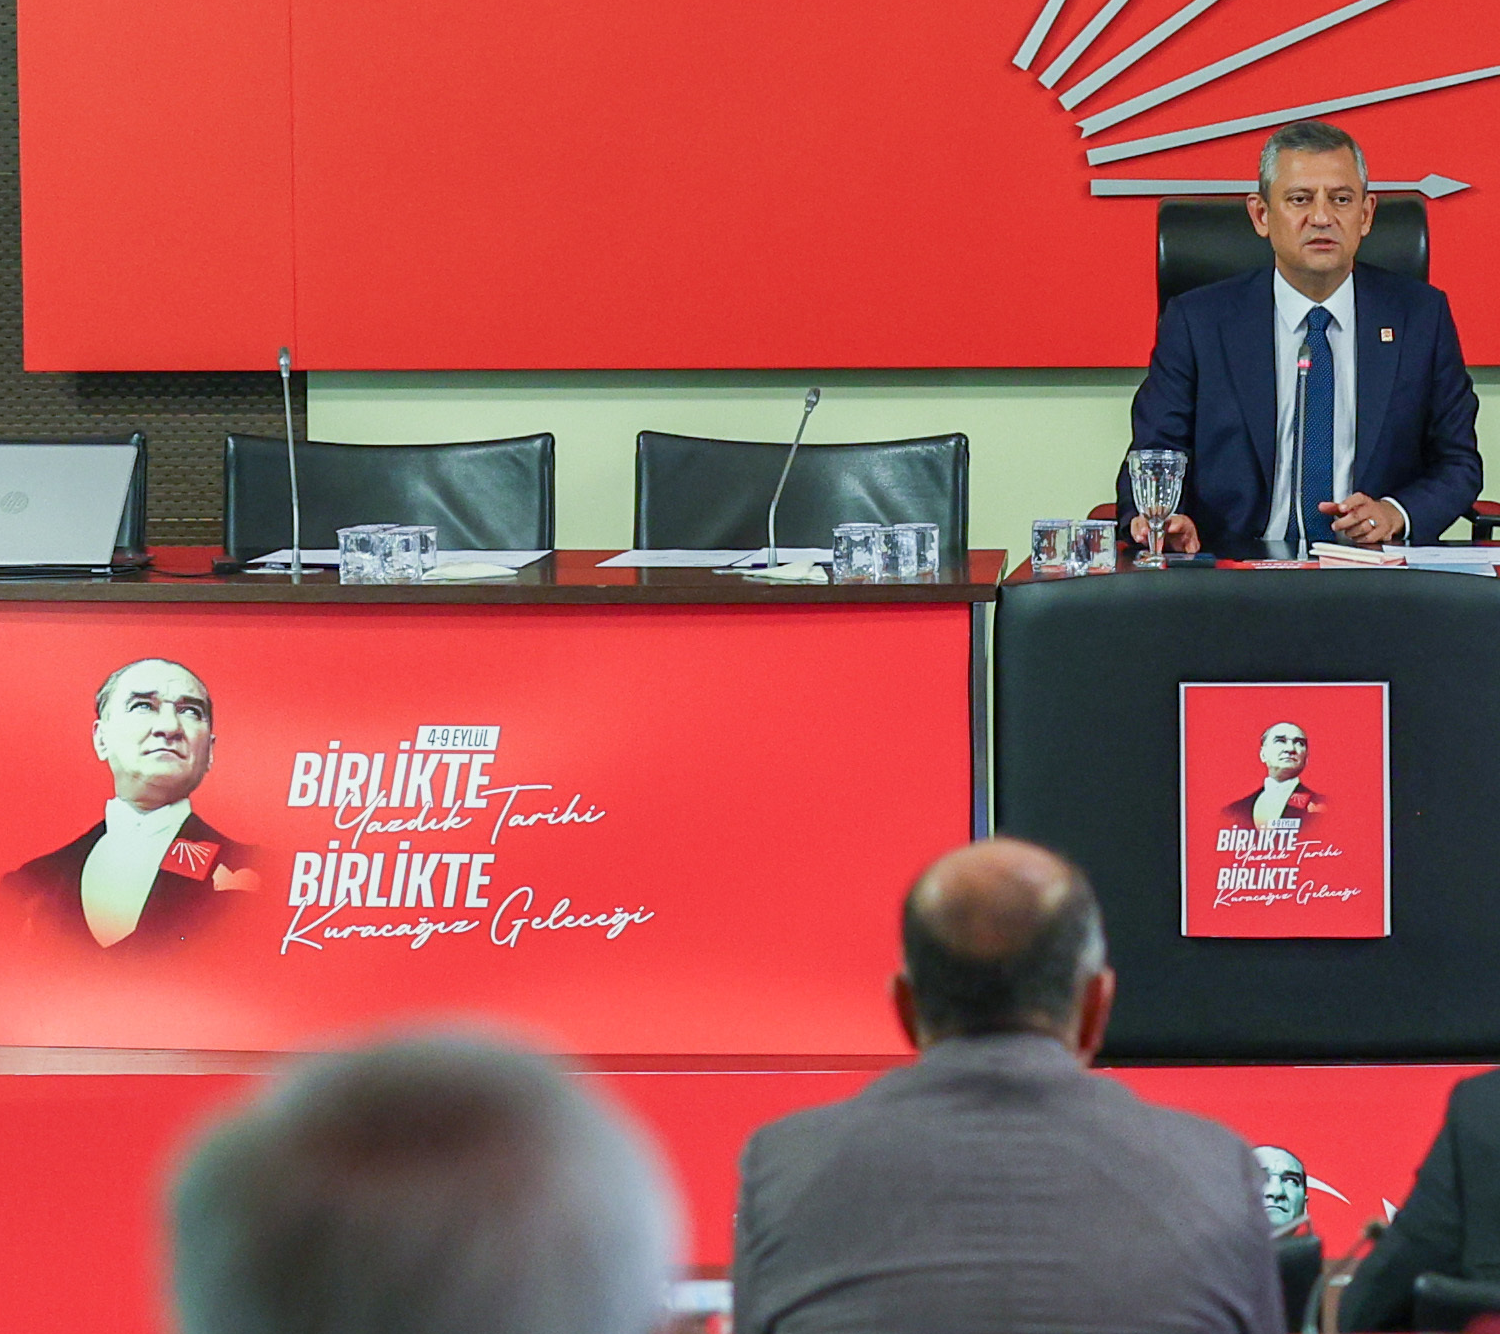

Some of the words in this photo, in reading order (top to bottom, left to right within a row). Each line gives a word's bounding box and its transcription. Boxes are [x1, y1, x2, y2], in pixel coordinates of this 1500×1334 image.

[427, 728, 449, 746] 4-9
[452, 728, 489, 747] EYLÜL
[287, 740, 495, 808] BİRLİKTE
[334, 789, 472, 849] Yazdık
[480, 784, 605, 845] Tarihi
[1216, 825, 1299, 852] BİRLİKTE
[287, 840, 495, 908] BİRLİKTE
[1216, 863, 1300, 890] BİRLİKTE
[280, 898, 479, 955] Kuracağız
[490, 886, 654, 948] Geleceği
